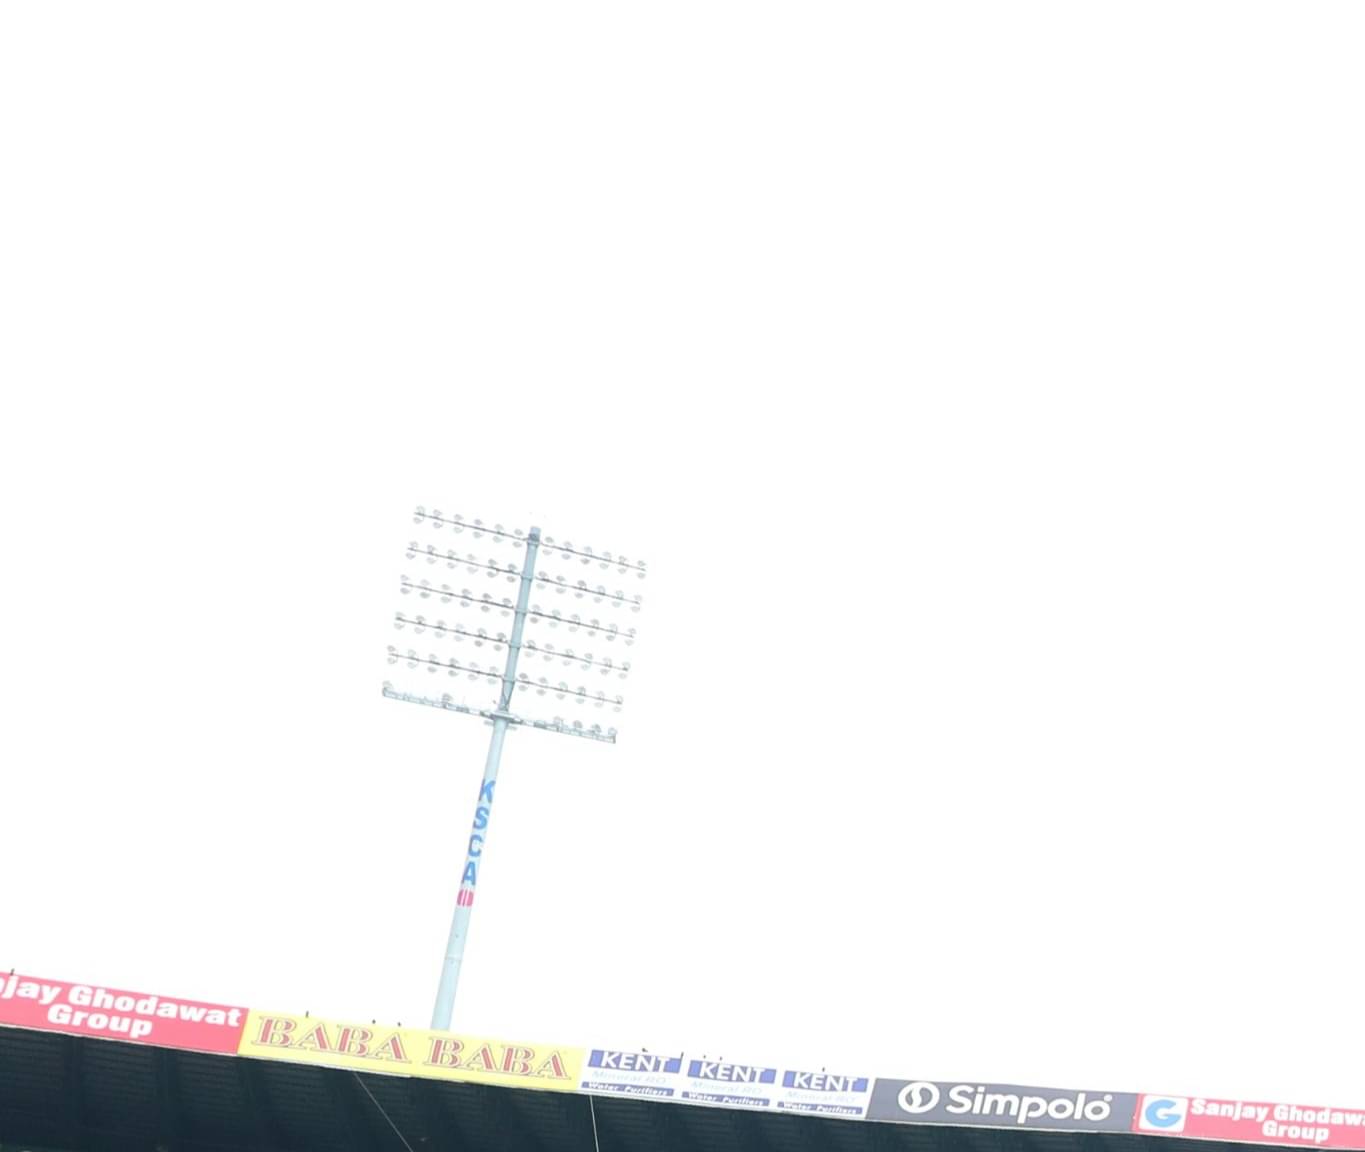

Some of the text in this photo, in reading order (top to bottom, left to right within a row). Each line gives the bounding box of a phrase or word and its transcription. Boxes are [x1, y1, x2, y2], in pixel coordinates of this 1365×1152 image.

[461, 779, 496, 886] KSCA
[48, 1003, 152, 1038] Group
[69, 986, 241, 1027] Ghodawat
[257, 1017, 570, 1079] BABA BABA
[601, 1052, 670, 1075] KENT
[701, 1062, 767, 1084] KENT
[794, 1072, 859, 1093] KENT
[946, 1083, 1111, 1123] Simpolo
[1191, 1099, 1269, 1123] Sanjay
[1262, 1122, 1329, 1144] Group
